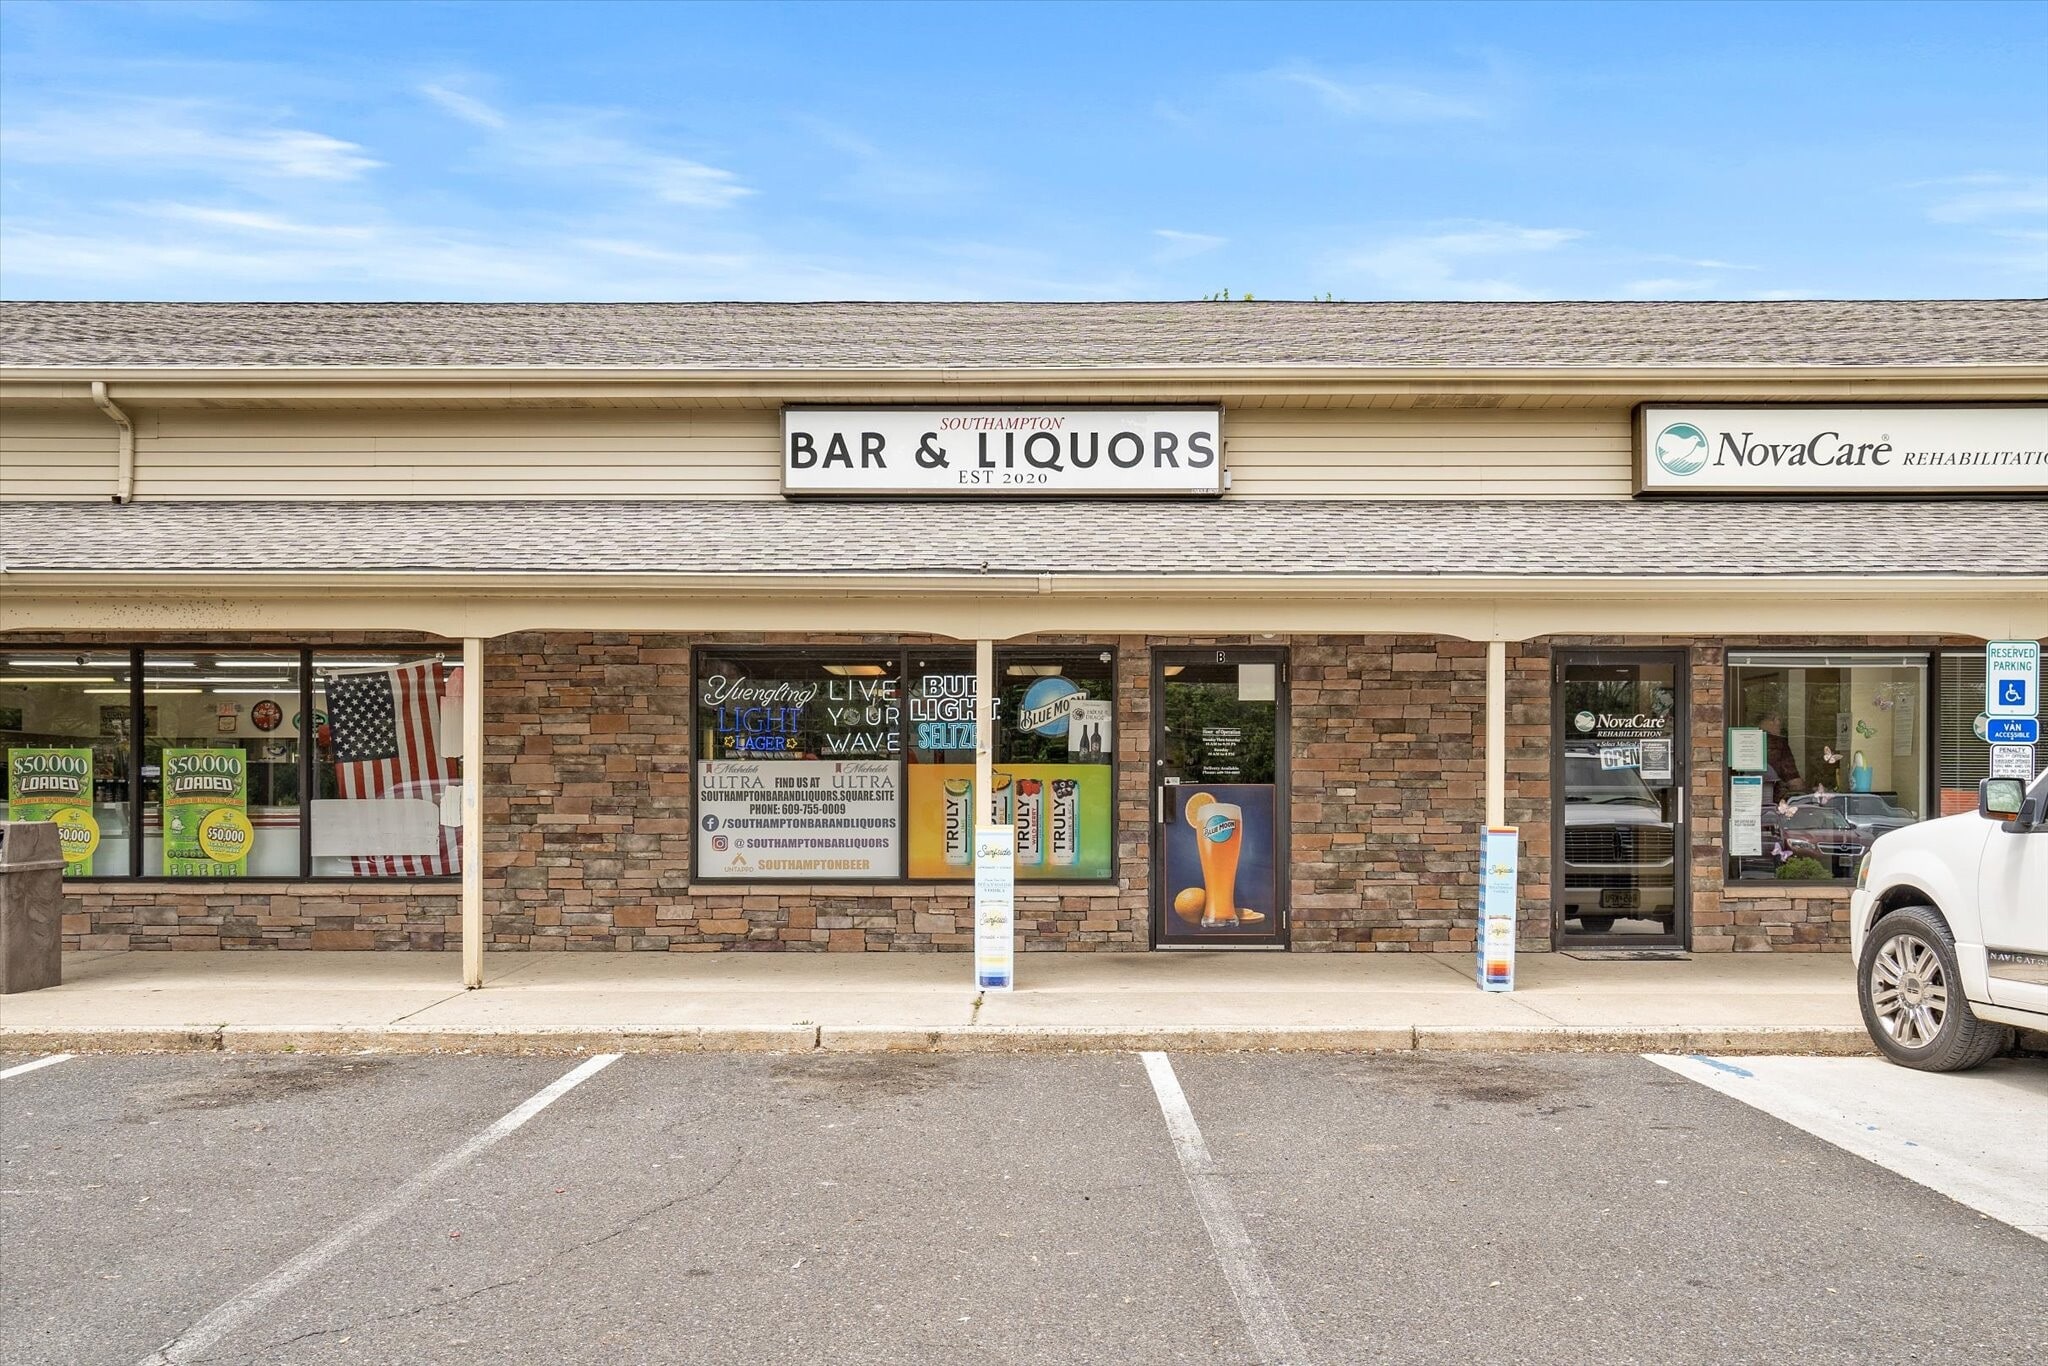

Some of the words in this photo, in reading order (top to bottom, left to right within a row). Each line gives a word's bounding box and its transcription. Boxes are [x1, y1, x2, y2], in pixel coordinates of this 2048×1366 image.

[940, 416, 1065, 431] SOUTHAMPTON
[790, 432, 887, 469] BAR
[915, 431, 950, 469] &
[978, 431, 1215, 472] LIQUORS
[1713, 431, 1893, 467] NovaCare
[958, 470, 994, 485] EST
[1003, 472, 1048, 485] 2020
[1216, 651, 1226, 663] B
[1991, 648, 2035, 658] RESERVED
[1993, 661, 2032, 671] PARKING
[704, 674, 818, 708] Yuengling
[829, 679, 898, 702] LIVE
[718, 706, 804, 733] LIGHT
[1020, 706, 1052, 731] BLUE
[1596, 713, 1665, 728] NovaCare
[2004, 723, 2022, 732] VAN
[735, 736, 786, 751] LAGER
[826, 732, 901, 752] WAVE
[1604, 748, 1640, 767] OPEN
[714, 762, 760, 774] Michelob
[843, 762, 889, 774] Michelob
[20, 776, 80, 791] LOADED
[175, 776, 233, 791] LOADED
[702, 775, 765, 789] ULTRA
[775, 777, 795, 788] FIND
[797, 777, 808, 788] US
[809, 777, 820, 788] AT
[832, 775, 896, 789] ULTRA
[701, 790, 895, 802] SOUTHAMPTONBARANDLIQUORS.SQUARE.SITE
[749, 804, 780, 815] PHONE:
[782, 804, 846, 814] 609-755-0009
[722, 818, 897, 829] /SOUTHAMPTONBARANDLIQUORS
[946, 799, 959, 853] TRULY
[1017, 799, 1030, 853] TRULY
[1053, 799, 1066, 853] TRULY
[1203, 825, 1219, 837] BLUE
[1219, 821, 1235, 830] MOON
[58, 828, 91, 843] 50,000
[207, 827, 245, 843] $50,000
[734, 838, 745, 849] @
[747, 838, 890, 849] SOUTHAMPTONBARLIQUORS
[977, 844, 1012, 858] Surfside
[758, 859, 870, 870] SOUTHAMPTONBEER
[1990, 952, 2048, 966] NAVIGATO
